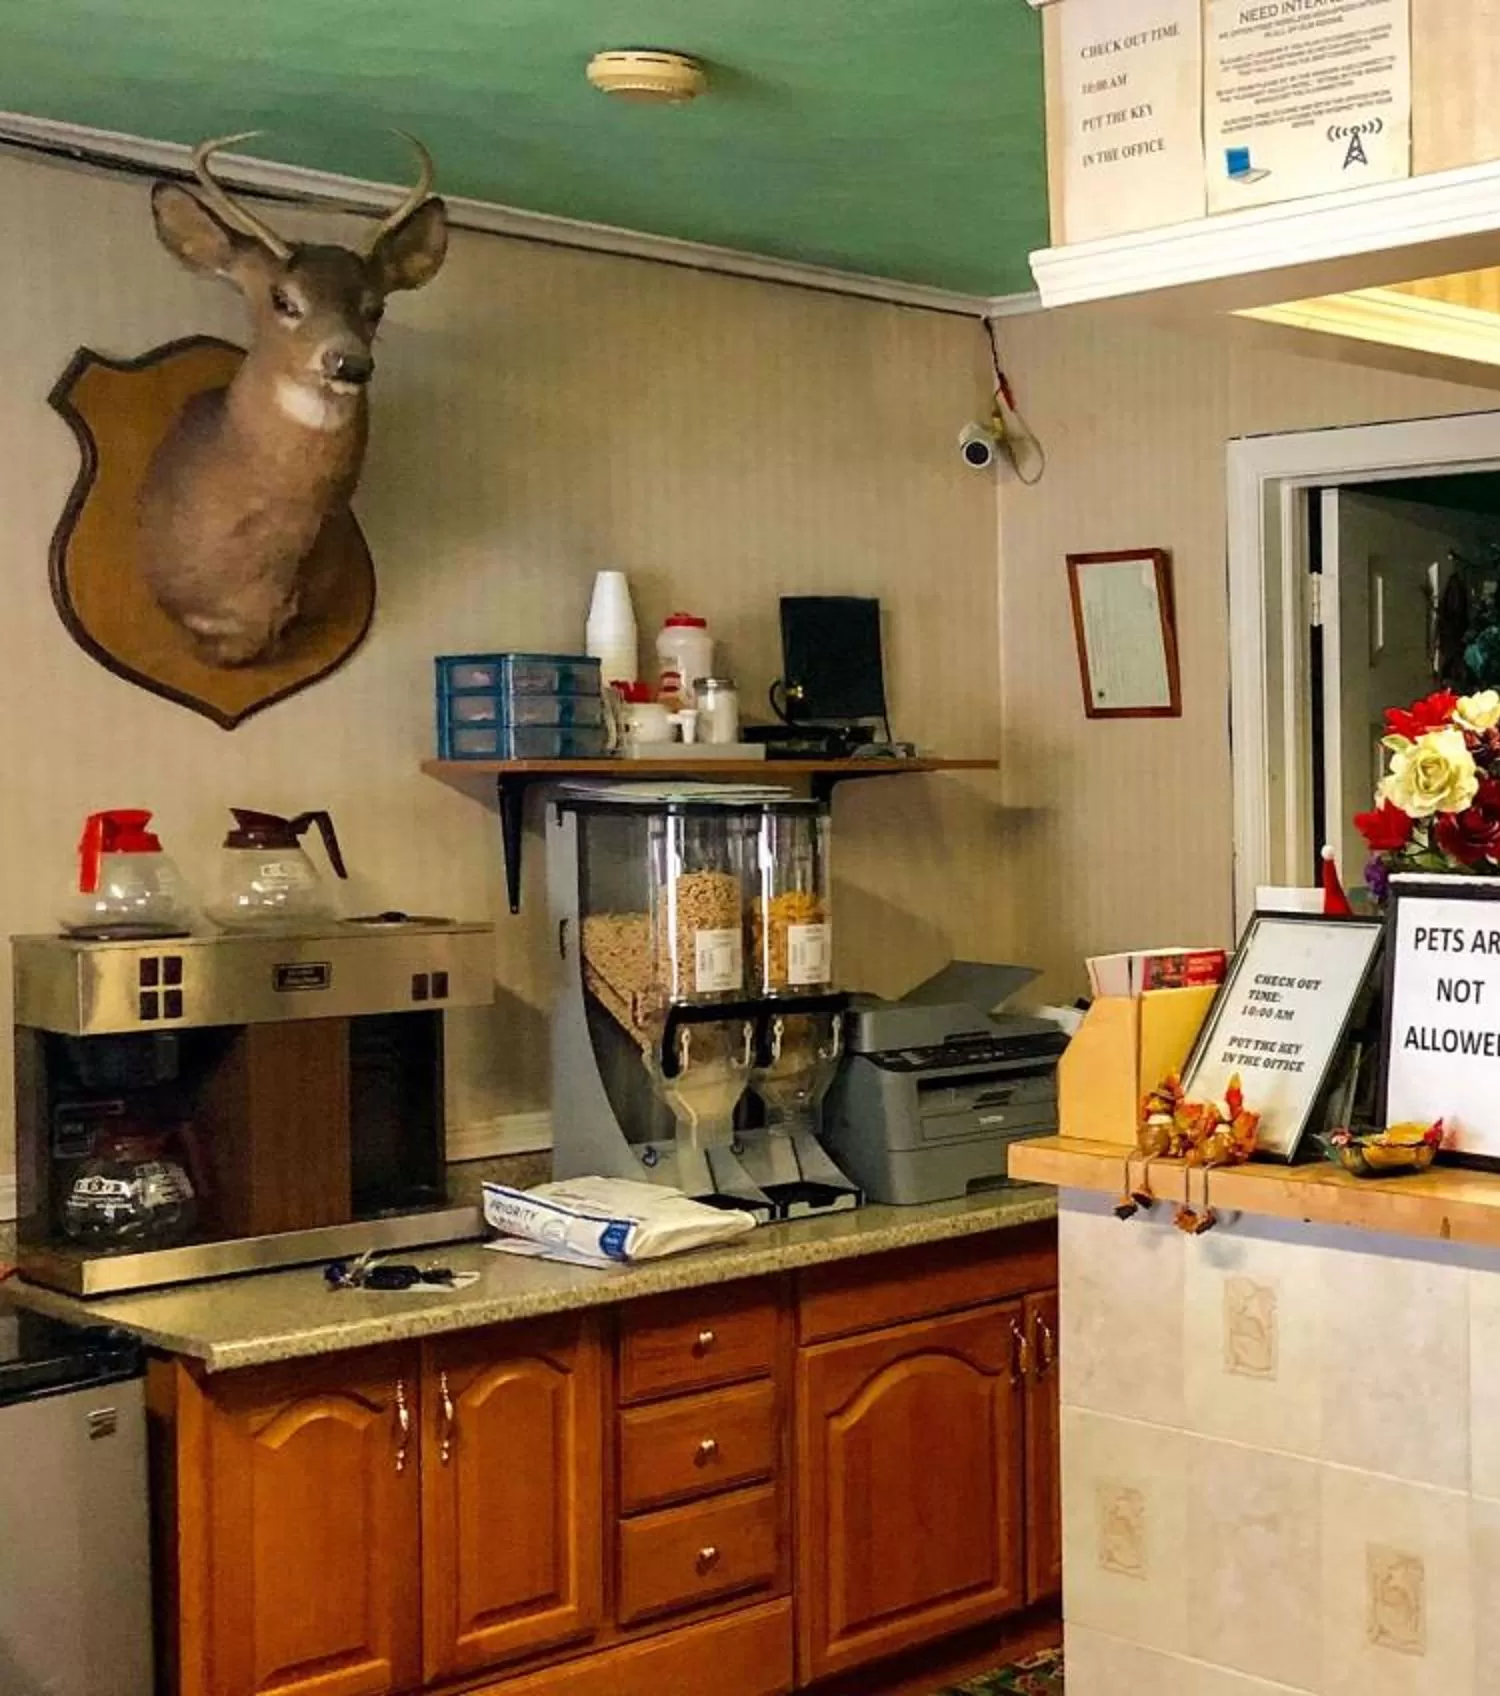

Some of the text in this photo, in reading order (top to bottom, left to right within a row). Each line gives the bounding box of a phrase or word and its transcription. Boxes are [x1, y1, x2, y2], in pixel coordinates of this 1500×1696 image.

[1239, 4, 1279, 24] NEED
[1081, 22, 1180, 58] CHECK OUT TIME
[1111, 74, 1127, 88] AM
[1082, 103, 1153, 133] PUT THE KEY
[1082, 138, 1165, 168] IN THE OFFICE
[1414, 927, 1465, 953] PETS
[1254, 974, 1322, 991] CHECK OUT
[1436, 978, 1486, 1004] NOT
[1241, 1005, 1295, 1021] 10:00 AM
[1228, 1036, 1303, 1055] PUT THE KEY
[1222, 1052, 1305, 1073] IN THE OFFICE
[490, 1200, 540, 1220] PRIORITY
